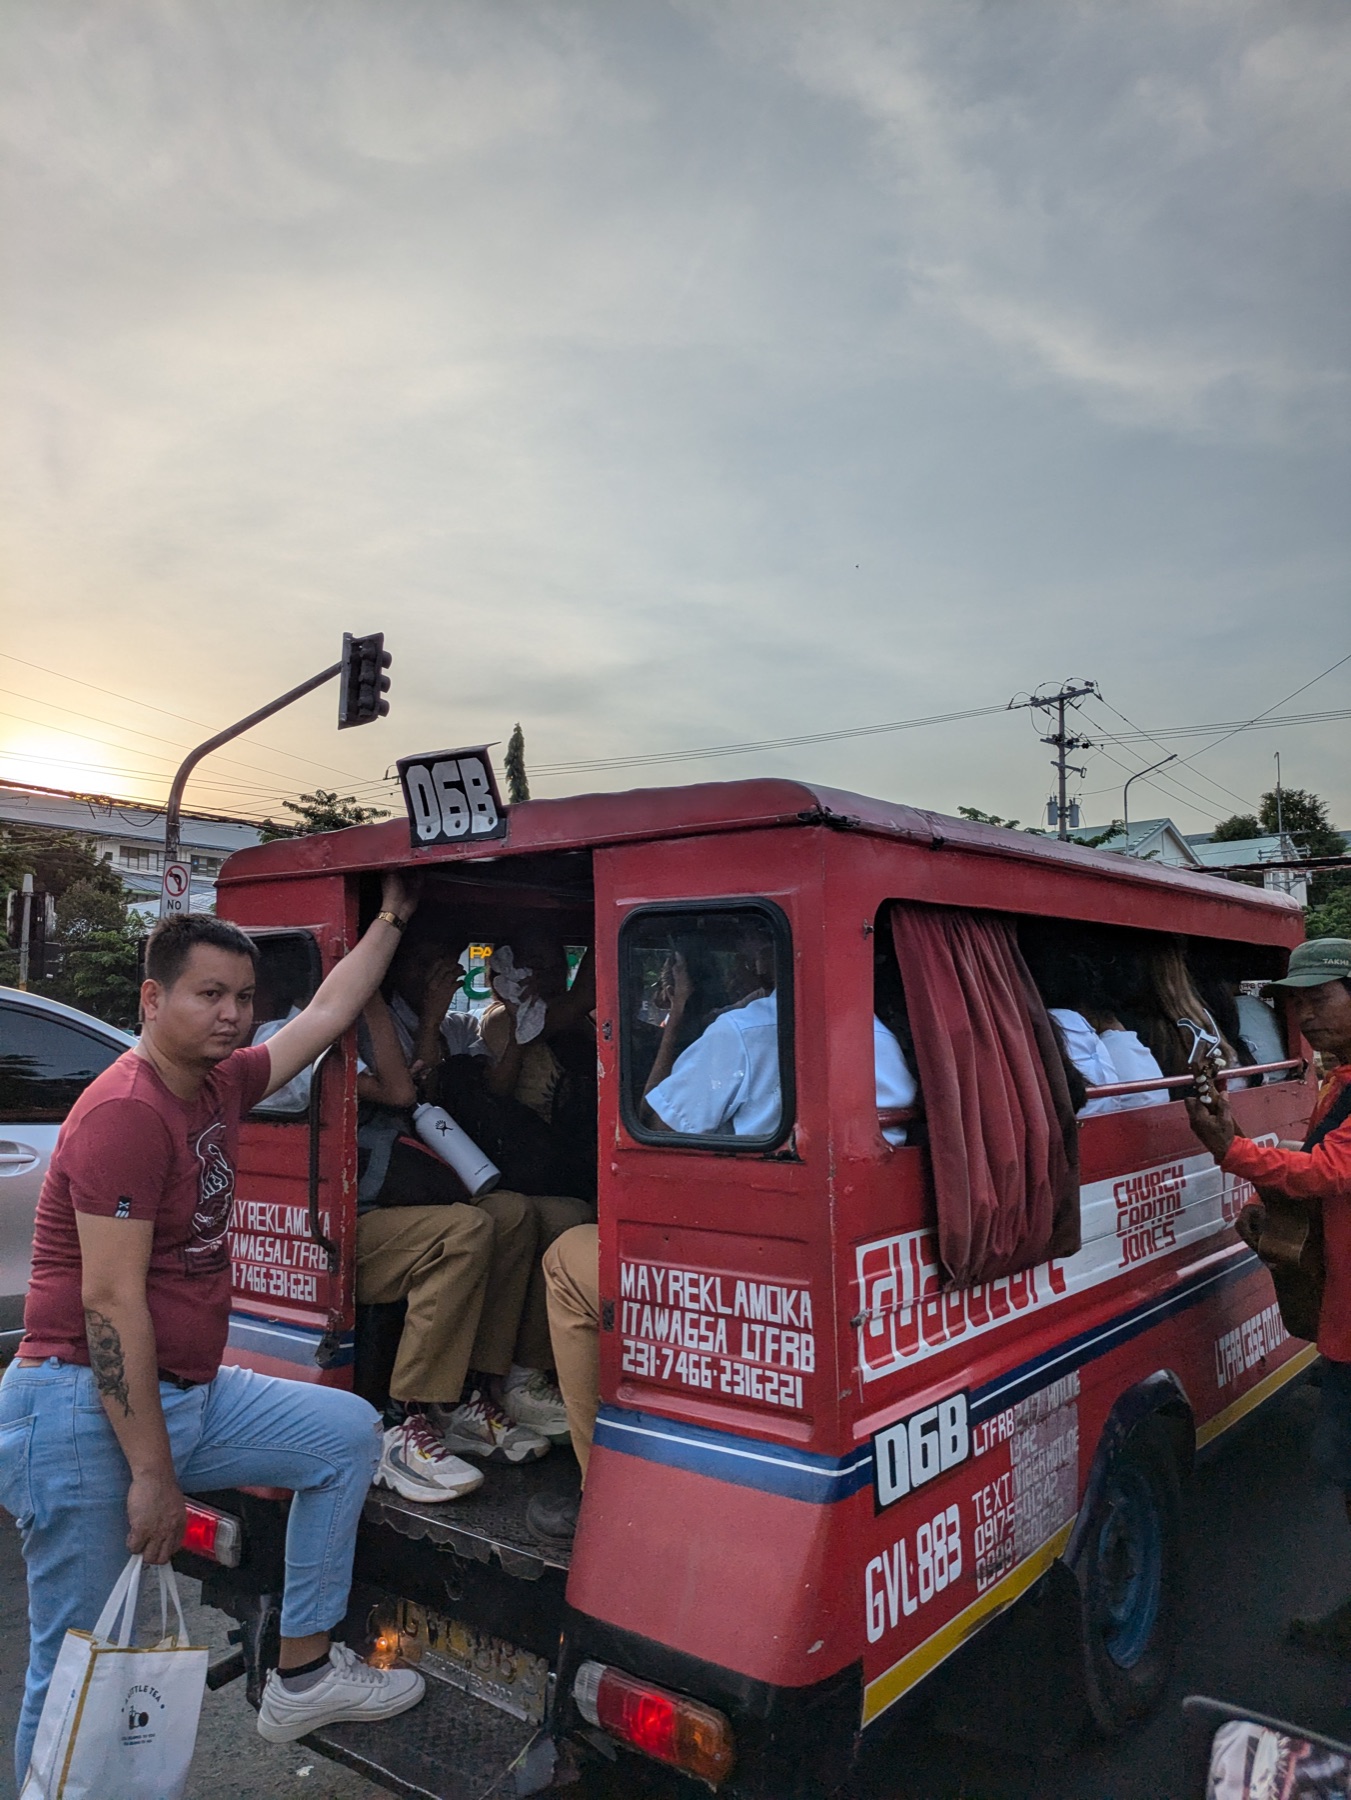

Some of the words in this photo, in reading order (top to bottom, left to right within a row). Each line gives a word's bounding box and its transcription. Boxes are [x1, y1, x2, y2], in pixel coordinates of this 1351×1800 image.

[406, 757, 498, 841] 06B
[167, 899, 182, 910] NO
[1113, 1164, 1186, 1209] CHURCH
[1116, 1191, 1186, 1238] CAPITOL
[1118, 1220, 1176, 1268] JONES
[741, 1323, 815, 1373] LTFRB
[874, 1393, 969, 1506] 06B
[972, 1408, 1015, 1457] LTFRB
[972, 1472, 1010, 1523] TEXT
[149, 1686, 162, 1703] TEA
